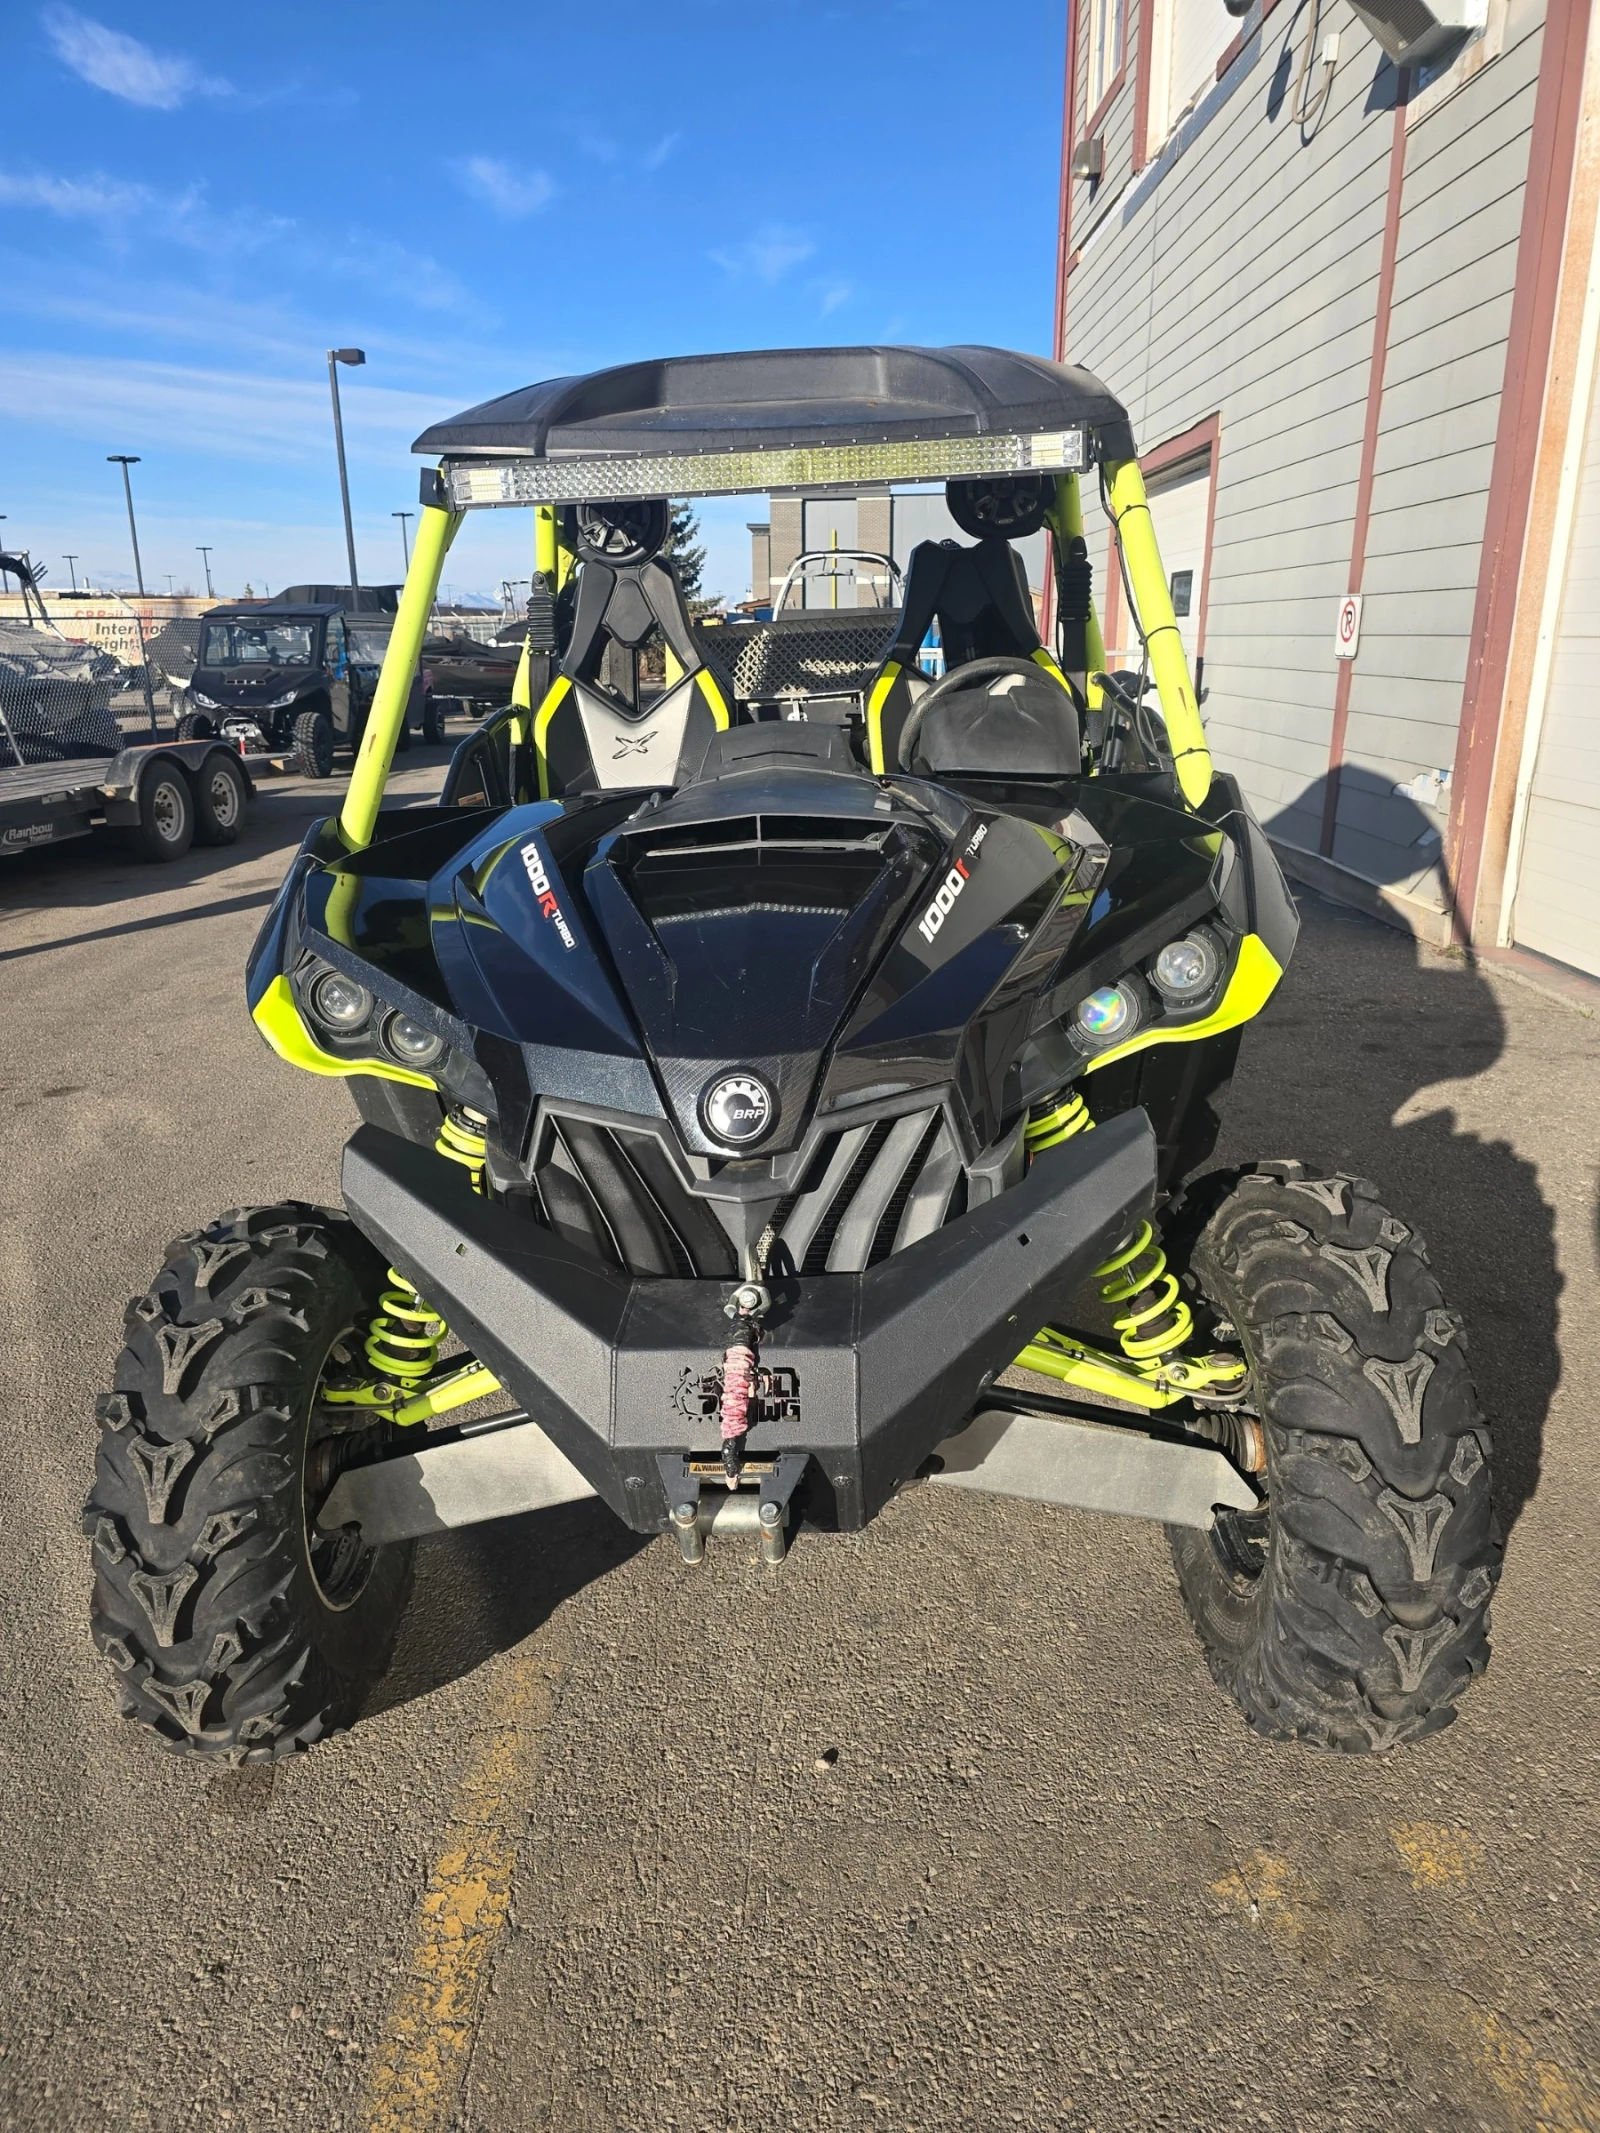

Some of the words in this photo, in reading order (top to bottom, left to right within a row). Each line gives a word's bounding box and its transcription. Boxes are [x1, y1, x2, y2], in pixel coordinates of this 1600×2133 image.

[83, 636, 135, 652] reight
[8, 823, 53, 840] Rainbow
[964, 823, 988, 856] TURBO
[520, 842, 558, 919] 1000R
[551, 908, 576, 949] TURBO
[733, 1109, 765, 1119] BRP
